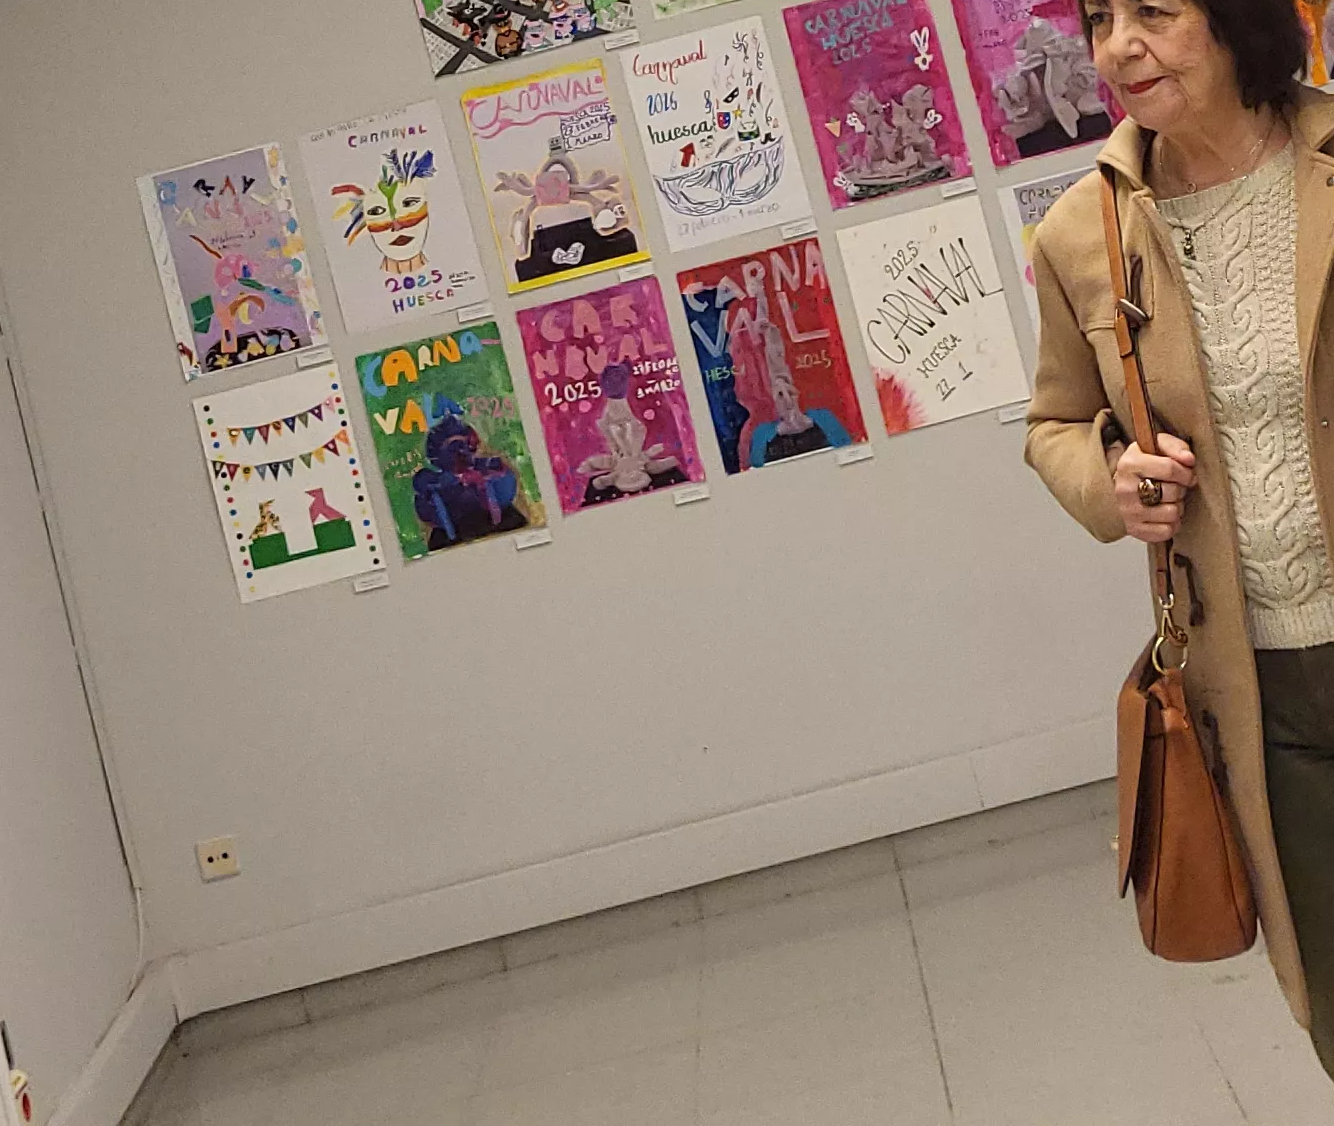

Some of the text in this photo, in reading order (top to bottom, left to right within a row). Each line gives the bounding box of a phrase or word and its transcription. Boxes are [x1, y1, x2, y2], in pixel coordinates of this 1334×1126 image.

[821, 11, 894, 50] HUESCA
[633, 39, 707, 85] Carnaval
[647, 120, 714, 145] huesca
[682, 241, 825, 312] CARNA
[885, 240, 919, 280] 2025
[385, 269, 442, 292] 2025
[392, 289, 454, 313] HUESCA
[540, 293, 637, 342] CAR
[867, 238, 1004, 364] CARNAVAL
[544, 381, 602, 406] 2025
